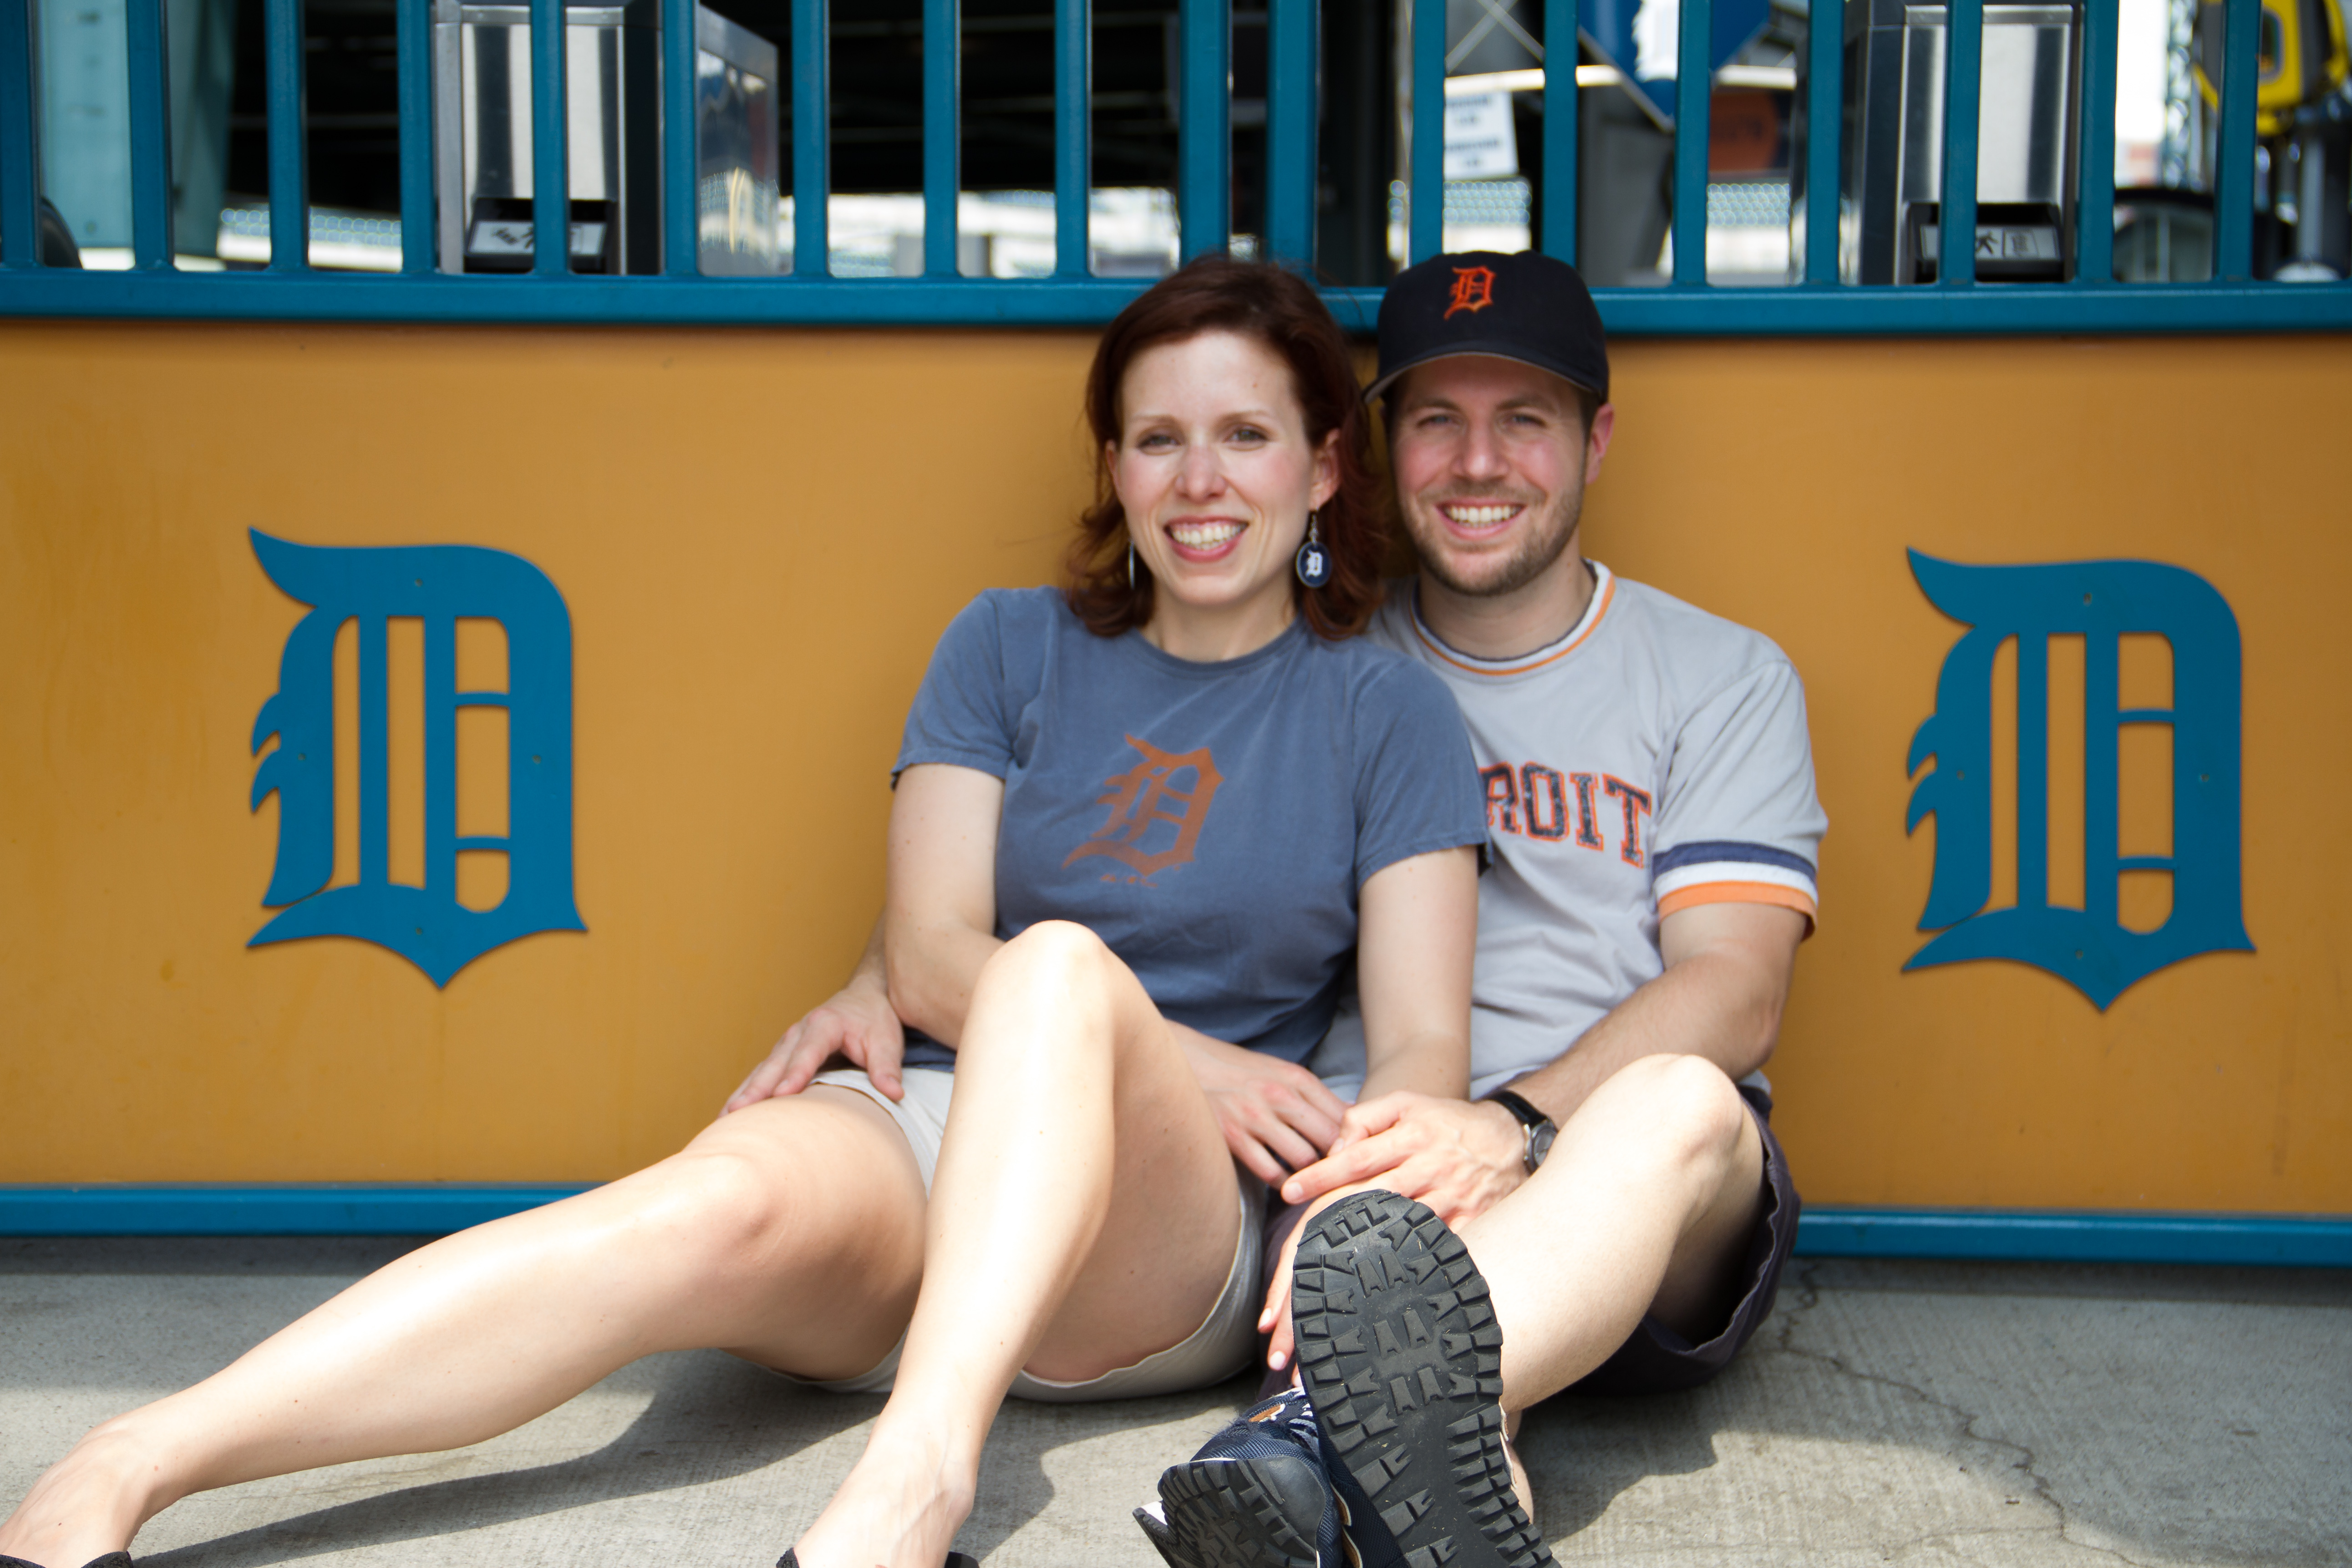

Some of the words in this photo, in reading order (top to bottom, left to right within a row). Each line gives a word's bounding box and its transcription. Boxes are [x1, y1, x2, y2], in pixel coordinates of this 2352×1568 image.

[1443, 265, 1497, 322] D
[246, 526, 588, 990] D
[1062, 733, 1225, 877] D
[1900, 546, 2257, 1014] D
